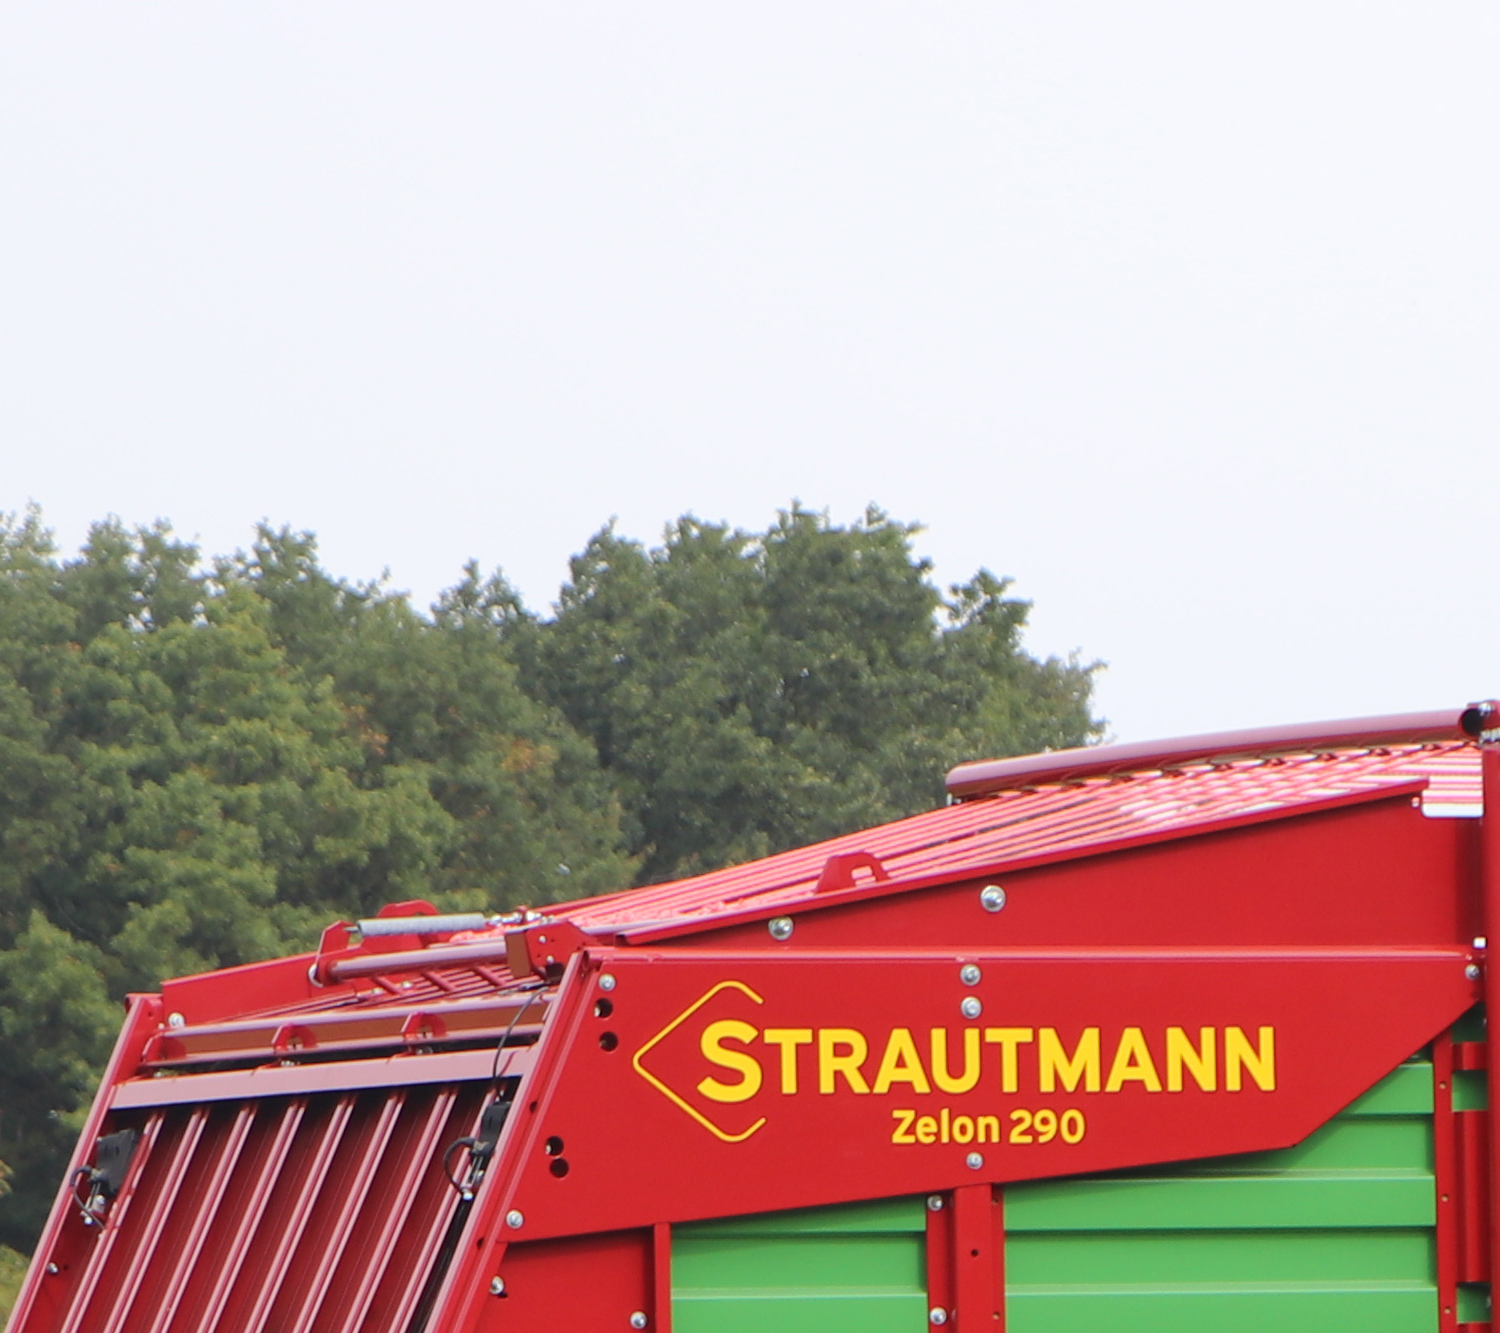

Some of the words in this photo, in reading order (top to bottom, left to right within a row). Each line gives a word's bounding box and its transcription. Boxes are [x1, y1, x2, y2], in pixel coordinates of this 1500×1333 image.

[697, 1020, 1275, 1102] STRAUTMANN
[892, 1110, 1000, 1143] Zelon
[1010, 1110, 1085, 1143] 290
